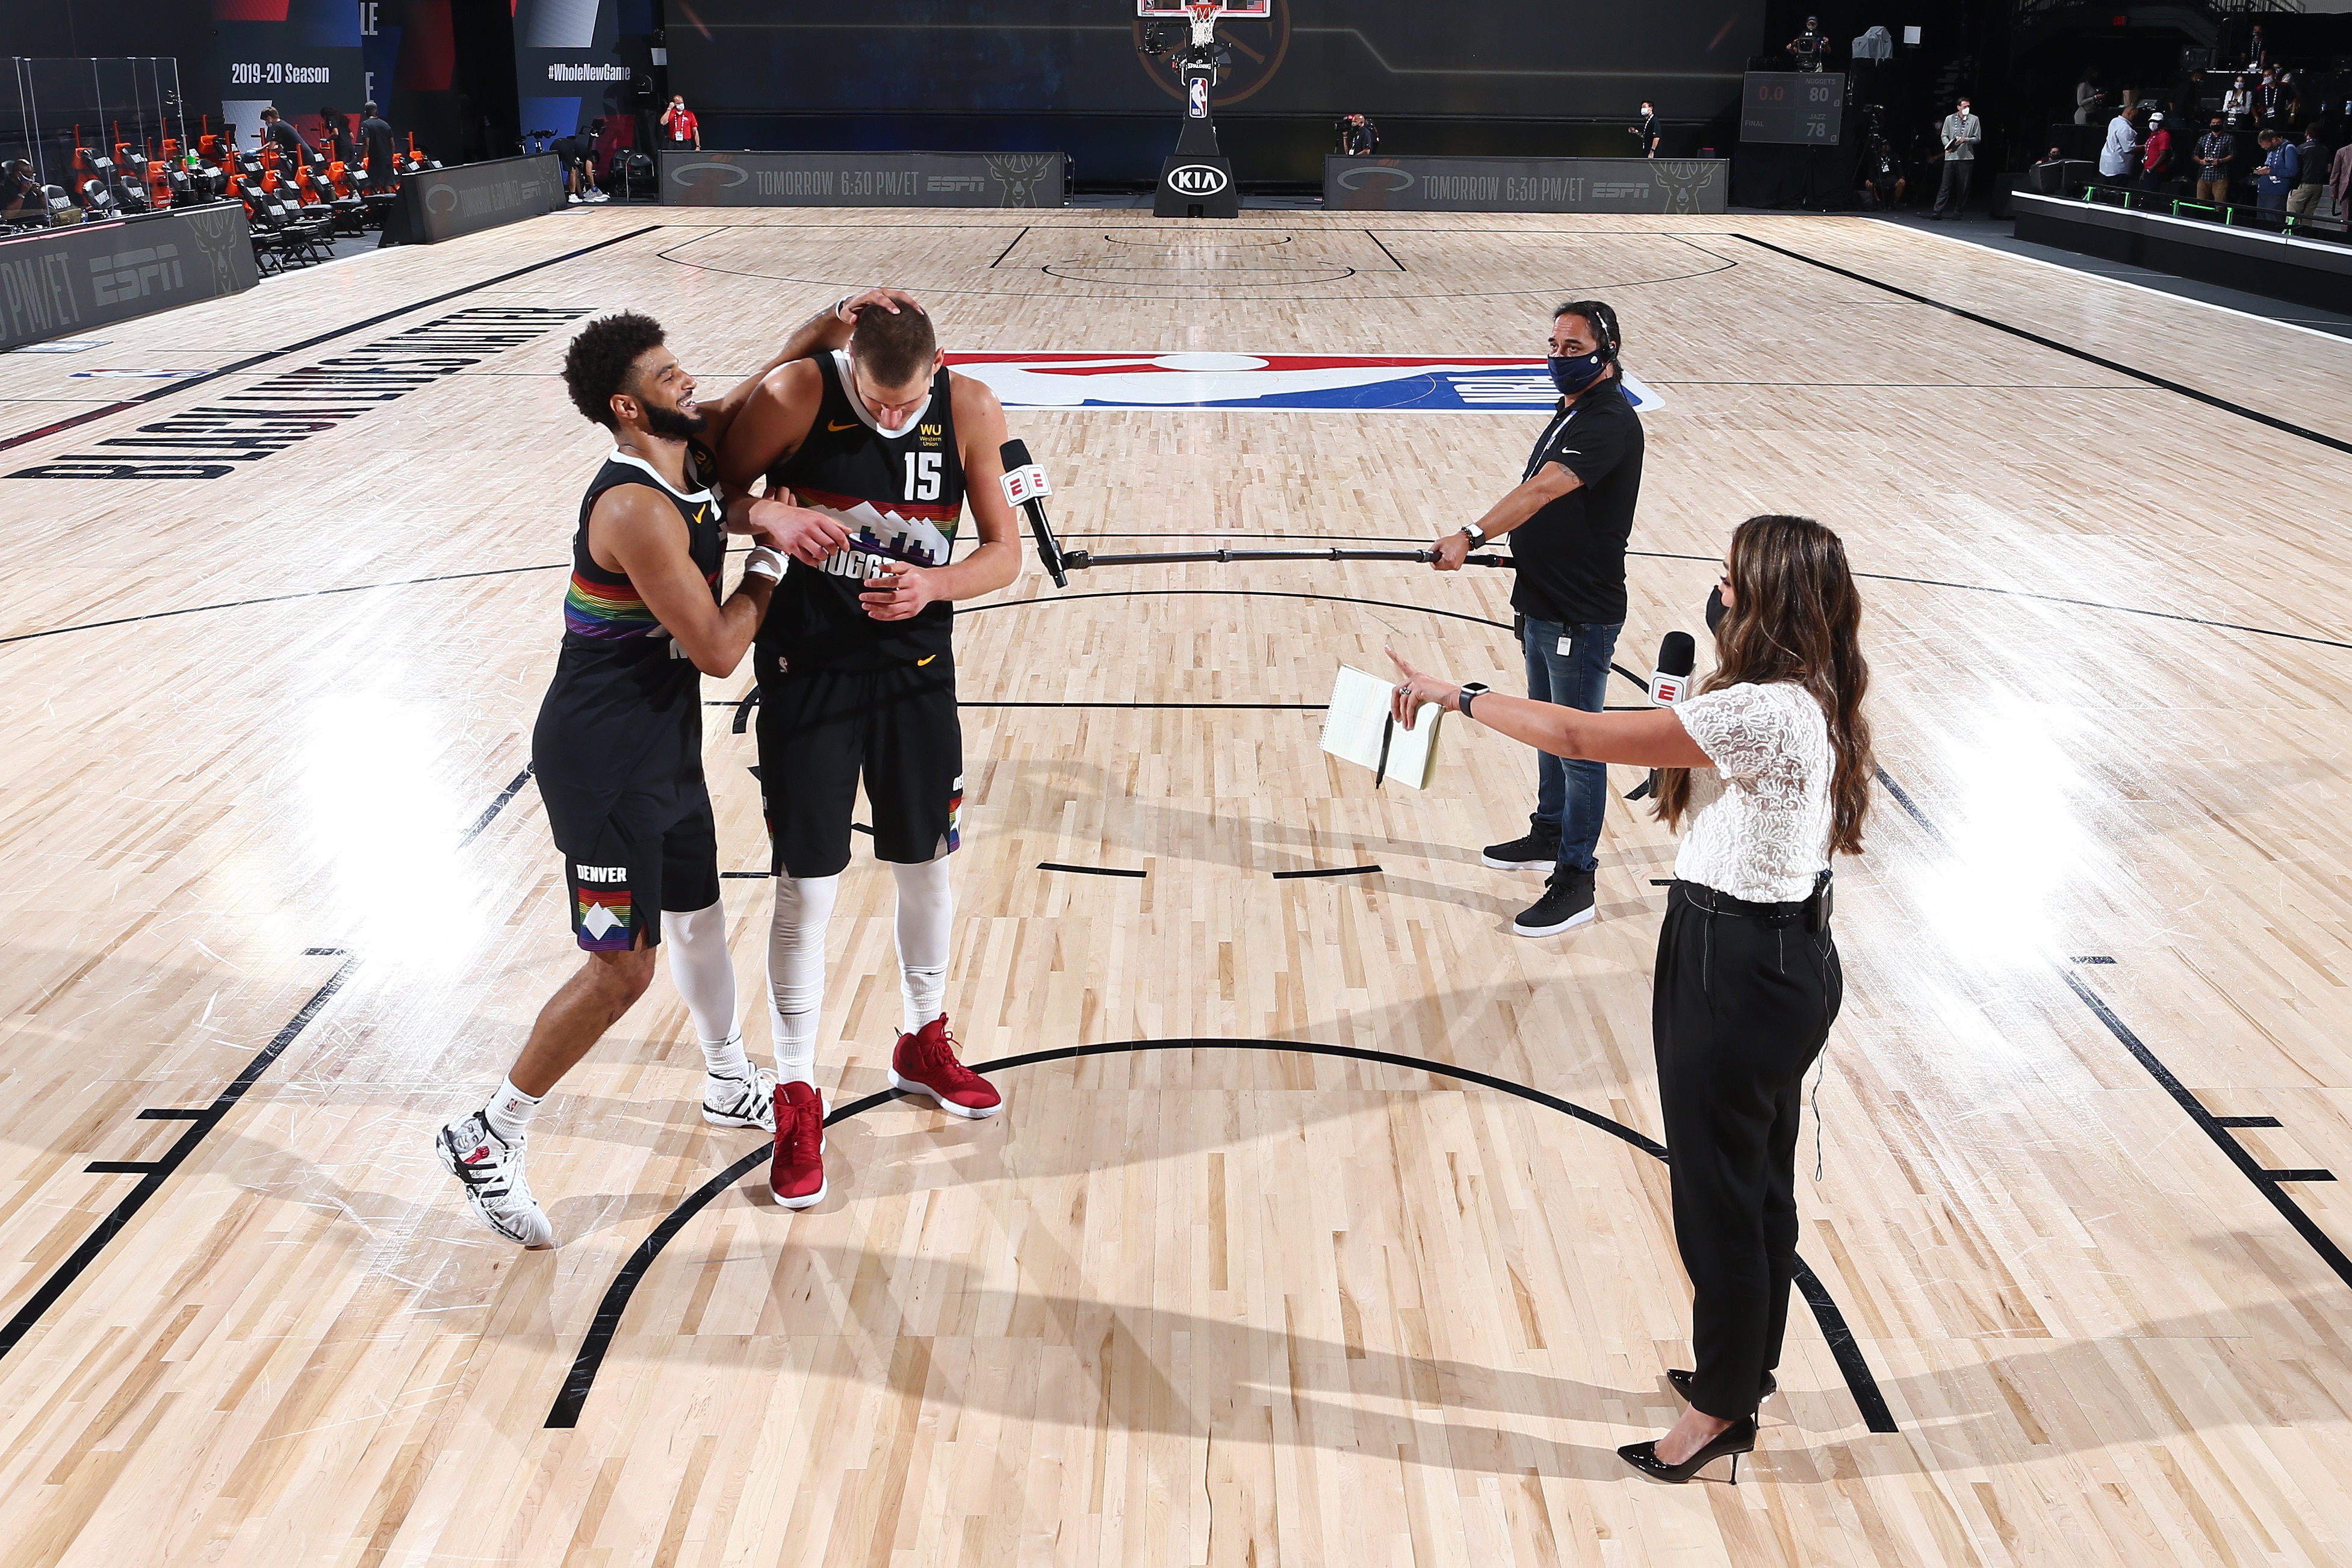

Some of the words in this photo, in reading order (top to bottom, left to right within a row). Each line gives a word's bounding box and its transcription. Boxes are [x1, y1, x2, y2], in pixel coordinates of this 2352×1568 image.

[232, 63, 282, 84] 2019-20
[285, 63, 329, 83] Season
[548, 63, 630, 81] #WholeNewGame
[1759, 86, 1784, 101] 0.0
[1809, 87, 1829, 102] 80
[1806, 123, 1825, 137] 78
[756, 171, 834, 196] TOMORROW
[842, 171, 871, 196] 6:30
[877, 172, 919, 196] PM/ET
[926, 176, 985, 192] ESPN
[1178, 172, 1217, 188] KIA
[1423, 175, 1499, 201] TOMORROW
[1506, 176, 1537, 202] 6:30
[1541, 177, 1584, 202] PM/ET
[1592, 182, 1649, 199] ESPN
[1, 252, 80, 336] PM/ET
[89, 244, 184, 306] ESPN
[349, 308, 601, 353] MATTER
[217, 358, 482, 401] LIVES
[920, 424, 942, 436] WU
[2, 407, 376, 479] BLACK
[904, 451, 942, 500] 15
[576, 864, 627, 882] DENVER
